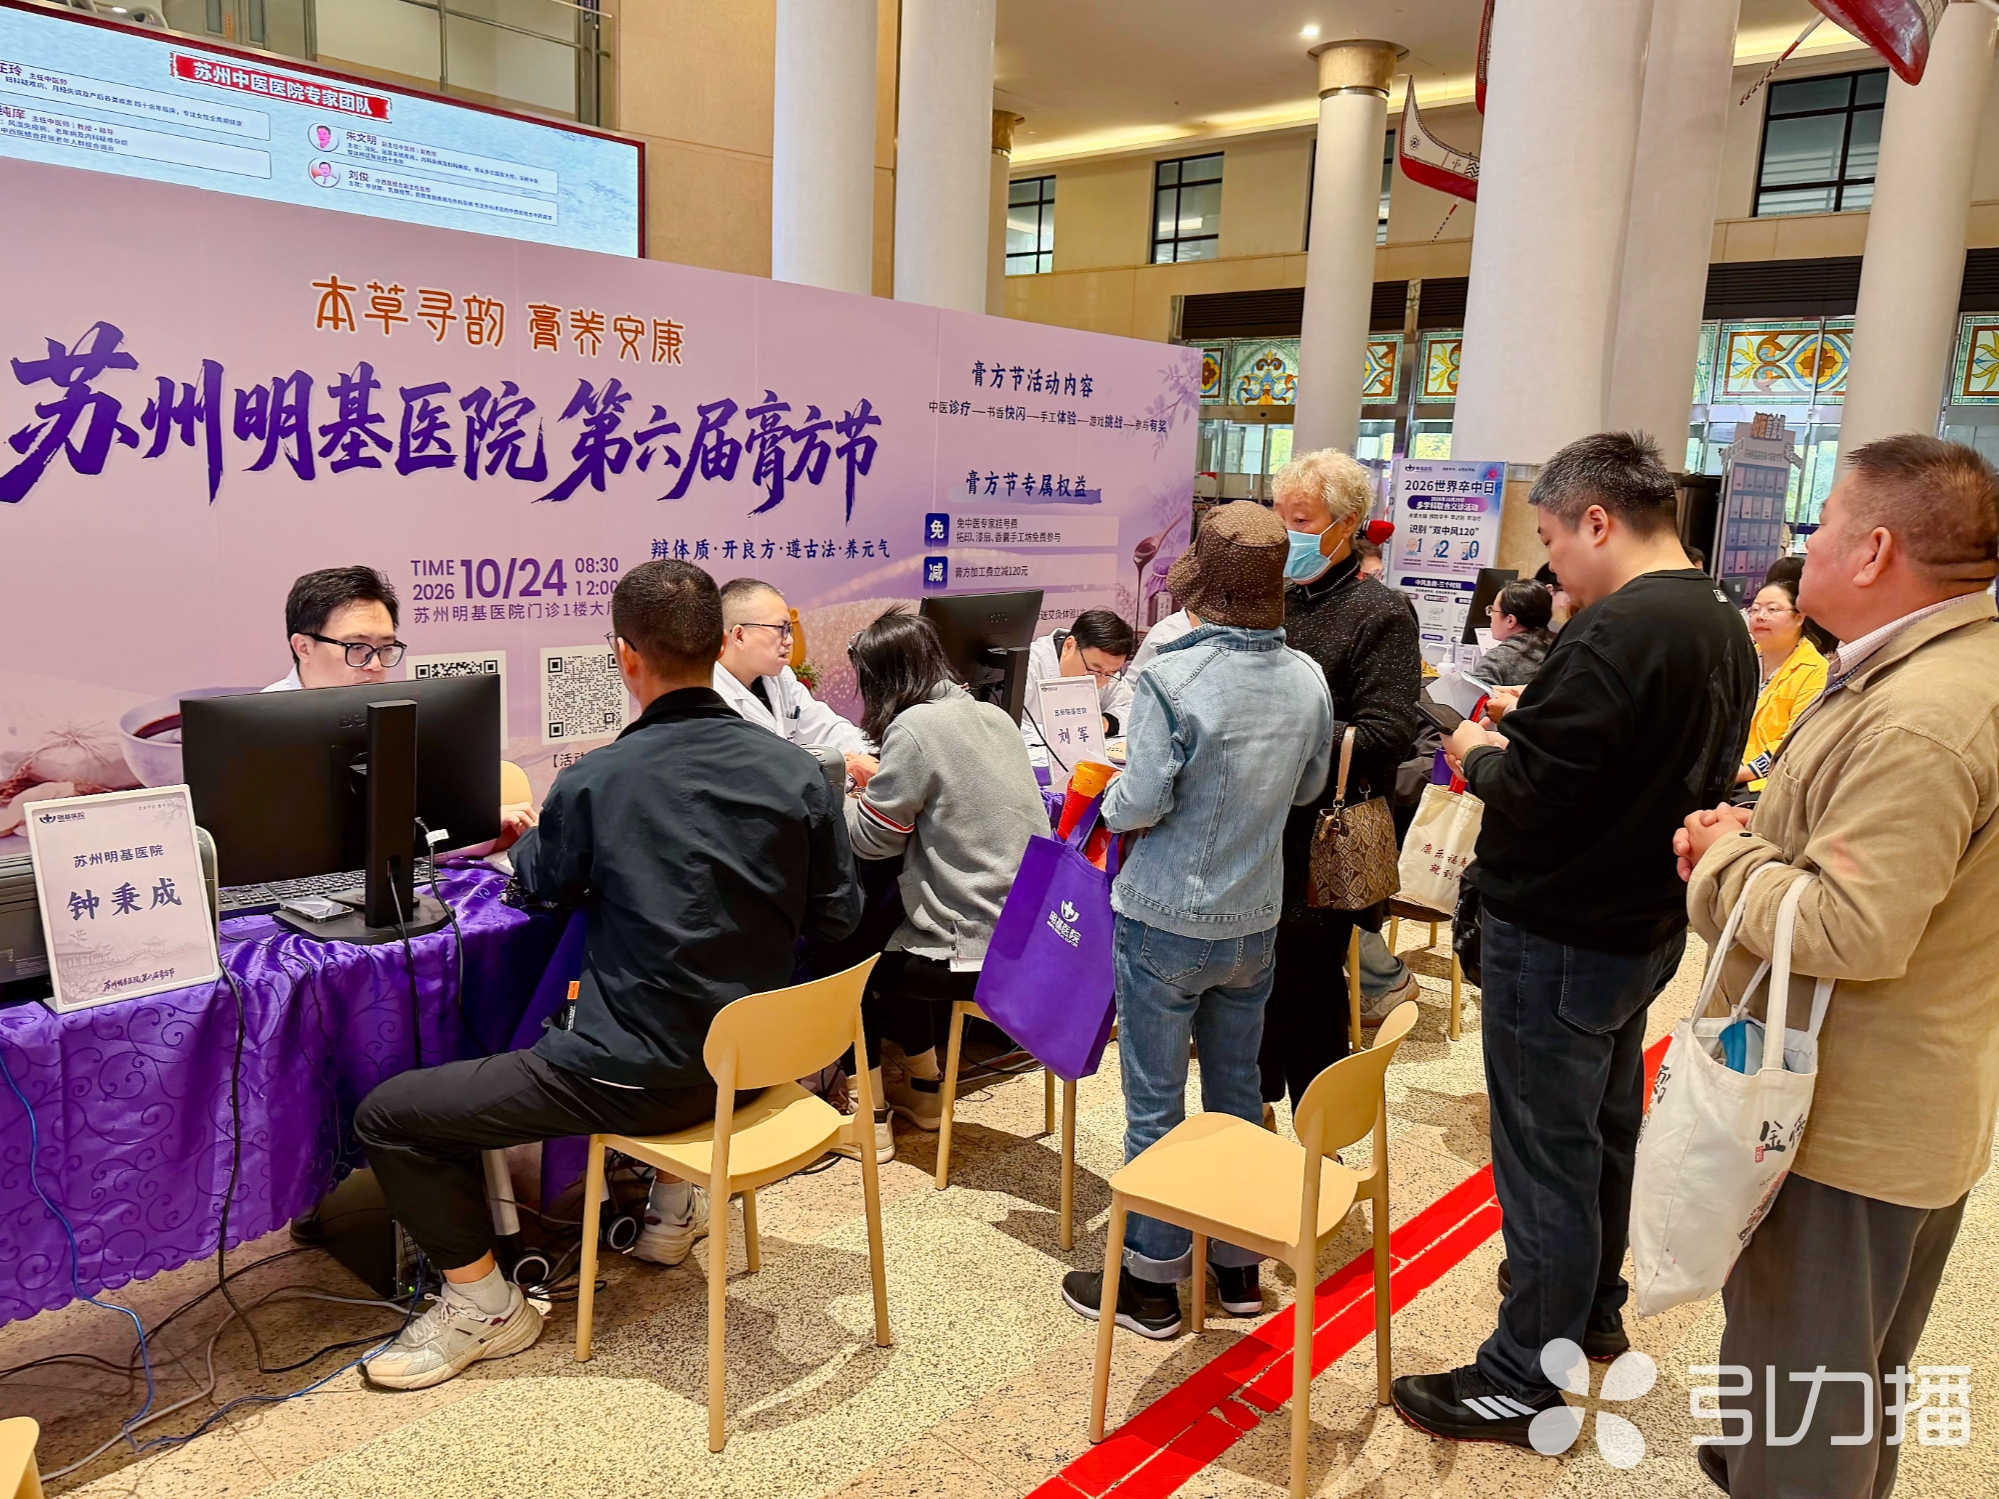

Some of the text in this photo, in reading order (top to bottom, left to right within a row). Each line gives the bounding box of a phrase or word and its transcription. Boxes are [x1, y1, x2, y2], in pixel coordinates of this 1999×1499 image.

[194, 61, 372, 115] 苏州中医医院专家团队
[346, 131, 377, 146] 朱文明
[348, 170, 369, 182] 刘俊
[312, 275, 684, 364] 本草寻韵 膏养安康
[972, 360, 1094, 398] 膏方节活动内容
[0, 321, 882, 523] 苏州明基医院 第六届膏方节
[966, 470, 1087, 497] 膏方节专属权益
[1405, 479, 1495, 494] 2026世界卒中日
[930, 519, 945, 539] 免
[956, 517, 1018, 530] 免中医专家挂号费
[1437, 539, 1449, 558] 2
[411, 559, 455, 576] TIME
[575, 557, 619, 573] 08:30
[928, 563, 944, 582] 减
[955, 565, 1029, 578] 膏方加工费立减120元
[460, 558, 567, 599] 10/24
[413, 583, 455, 600] 2026
[1058, 725, 1090, 745] 刘军
[73, 844, 165, 868] 苏州明基医院
[66, 877, 182, 921] 钟秉成
